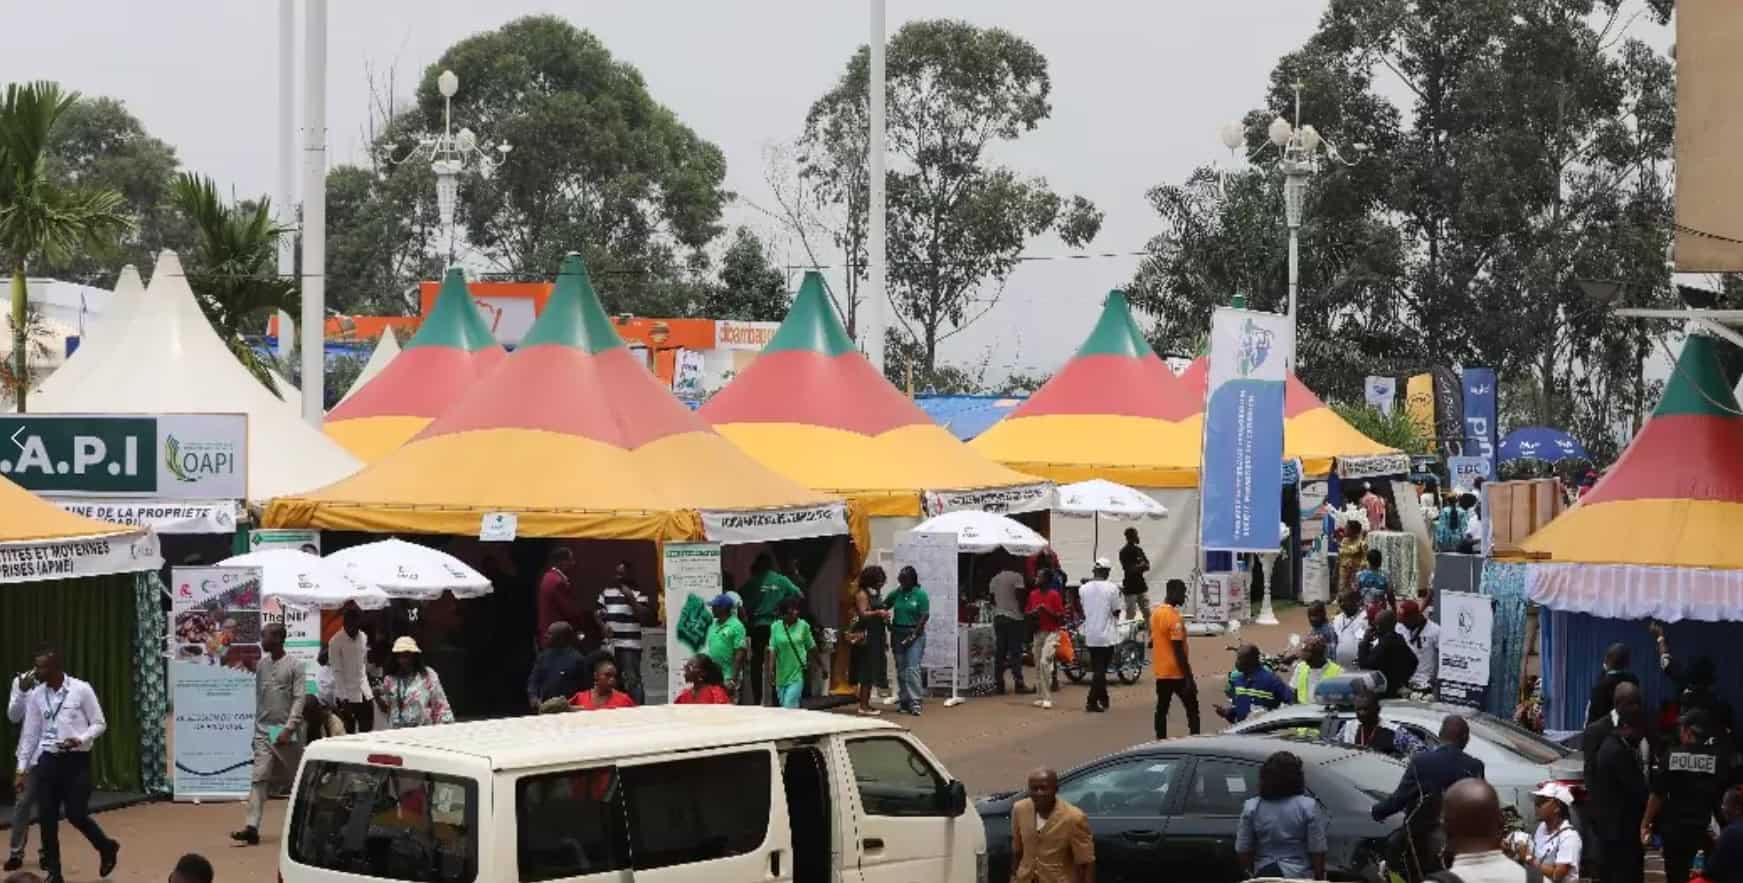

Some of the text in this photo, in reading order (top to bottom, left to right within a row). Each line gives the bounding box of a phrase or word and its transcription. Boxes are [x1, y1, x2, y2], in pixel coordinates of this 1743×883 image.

[183, 452, 233, 474] OAPI
[65, 506, 94, 517] INE
[97, 507, 114, 518] DE
[118, 507, 134, 518] LA
[0, 541, 111, 563] TITES ET MOYENNES
[0, 561, 33, 578] RISES
[263, 613, 282, 622] The
[1671, 756, 1713, 770] POLICE
